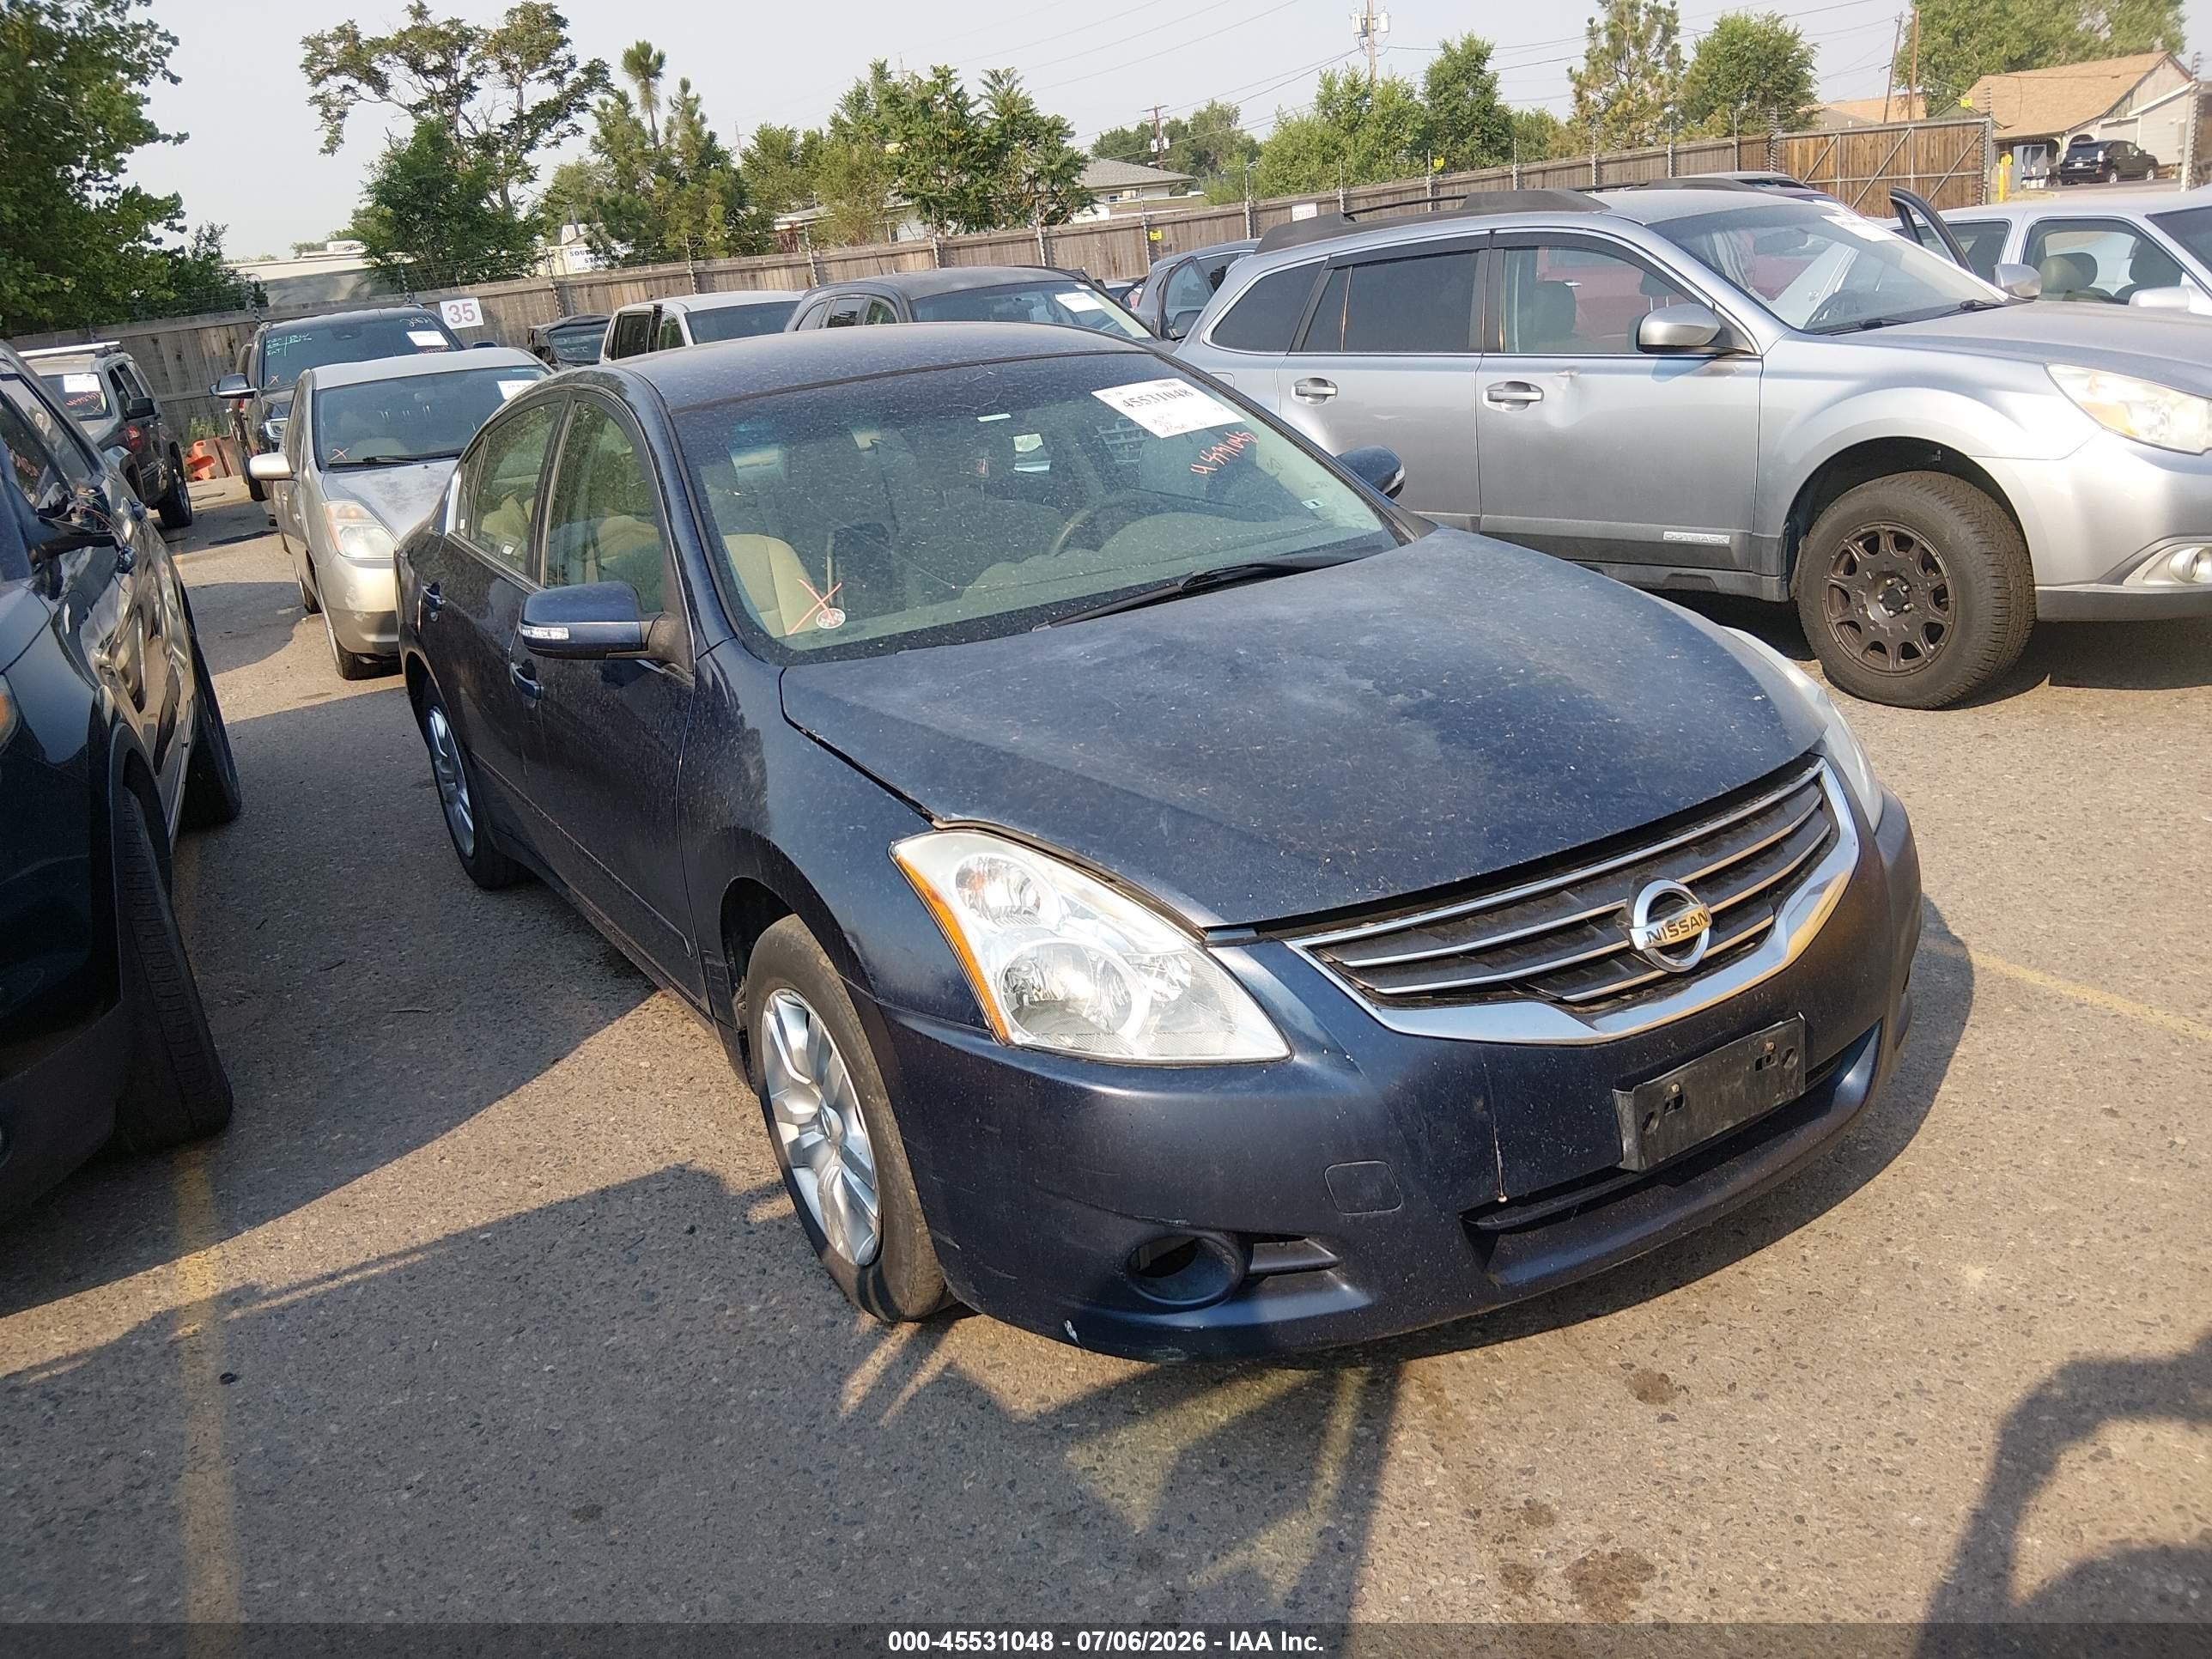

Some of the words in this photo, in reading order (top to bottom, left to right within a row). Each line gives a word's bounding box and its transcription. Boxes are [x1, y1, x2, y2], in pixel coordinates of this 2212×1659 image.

[448, 302, 476, 324] 35
[1121, 387, 1194, 409] 45531048
[1645, 910, 1709, 944] NISSAN
